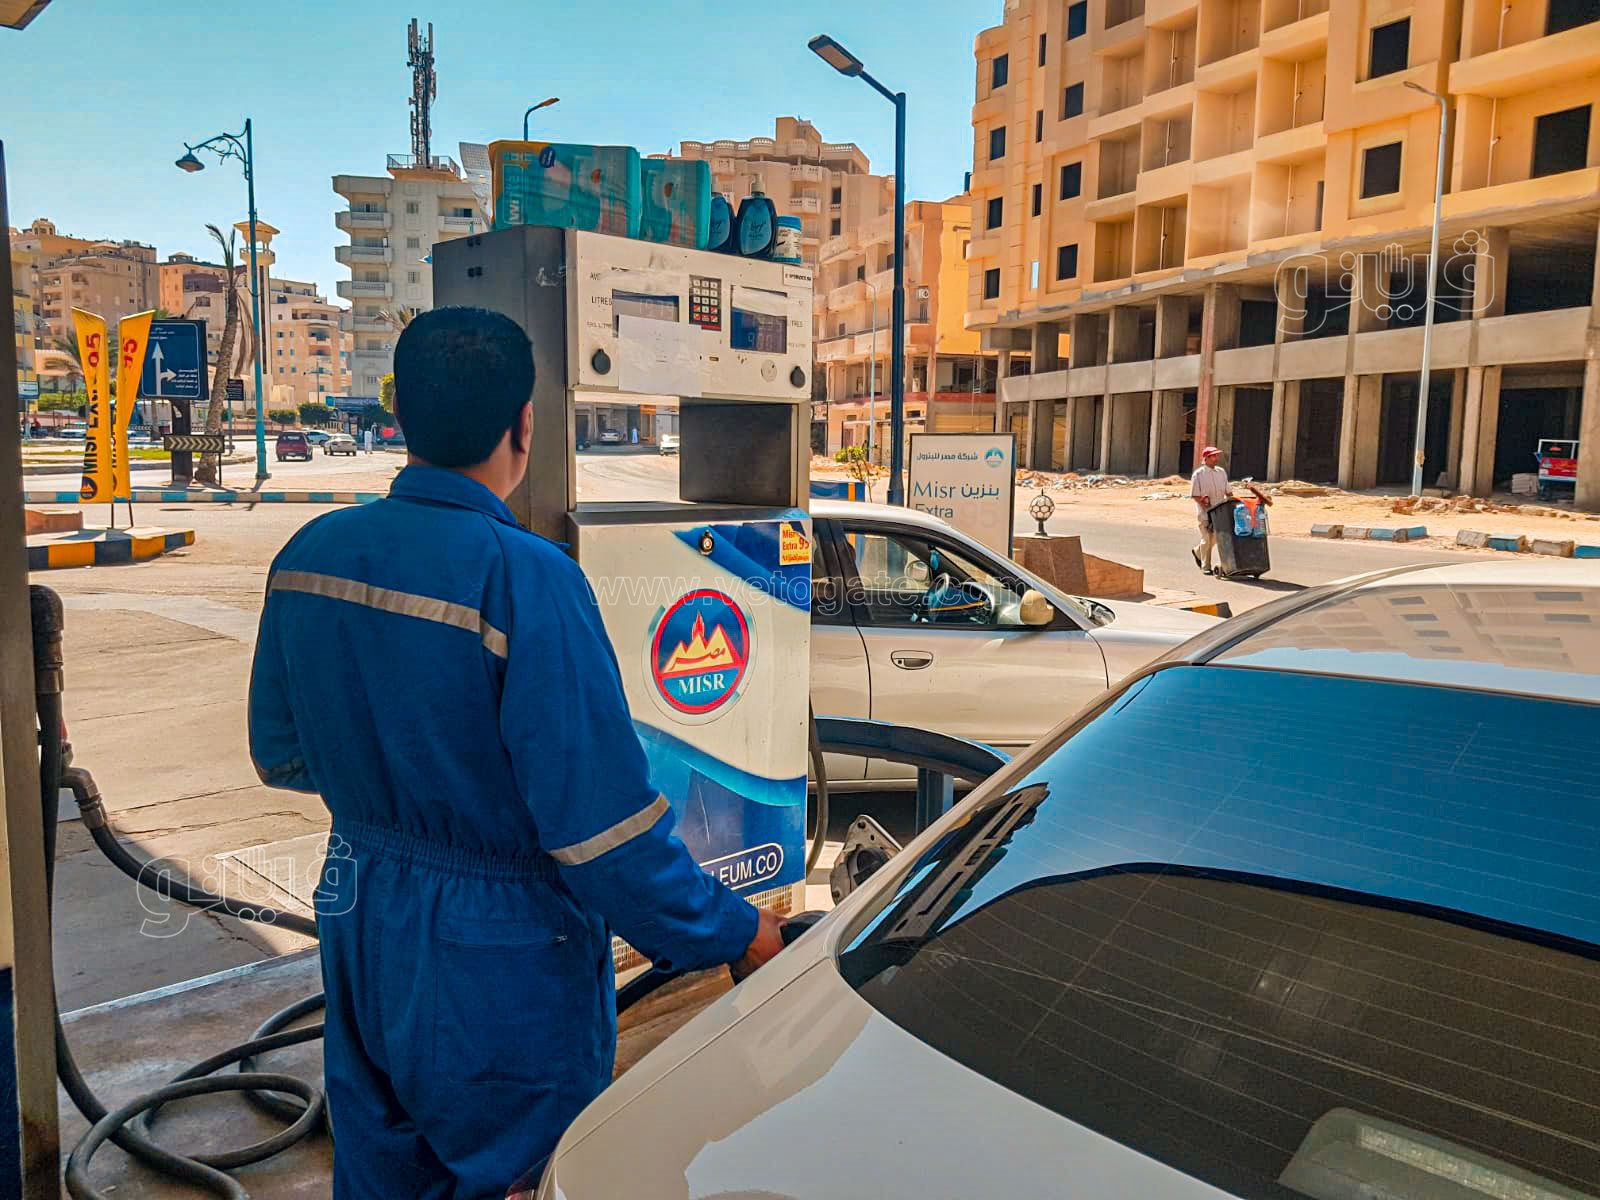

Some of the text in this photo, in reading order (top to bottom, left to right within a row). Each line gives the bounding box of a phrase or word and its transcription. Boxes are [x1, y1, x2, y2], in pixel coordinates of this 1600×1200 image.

[913, 480, 956, 499] Misr
[961, 482, 1000, 500] بنزين
[670, 647, 726, 671] مصر
[677, 672, 726, 697] MISR
[711, 851, 778, 885] EUM.CO
